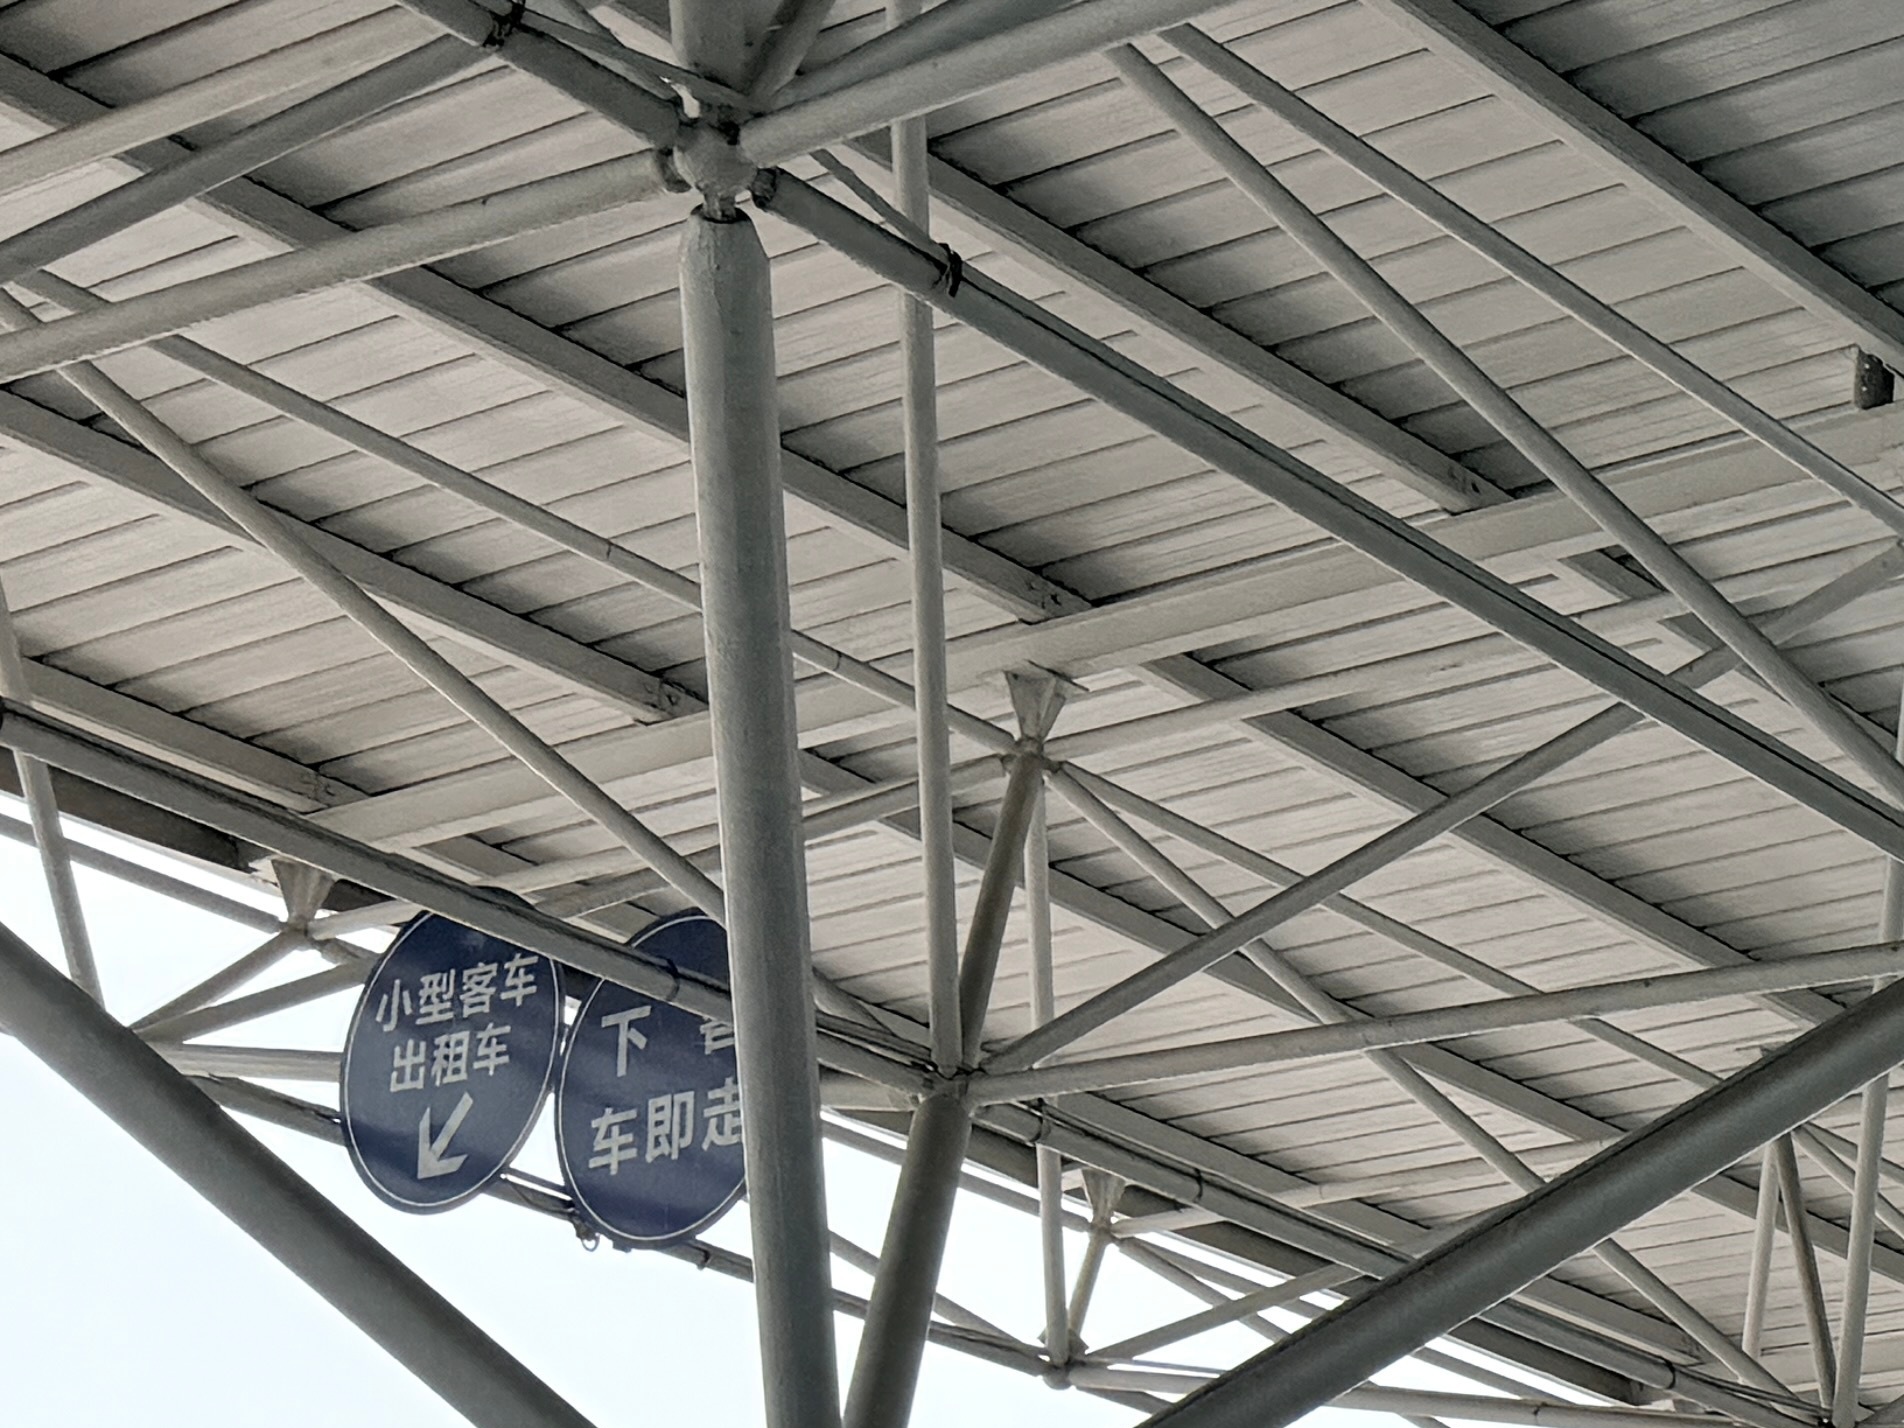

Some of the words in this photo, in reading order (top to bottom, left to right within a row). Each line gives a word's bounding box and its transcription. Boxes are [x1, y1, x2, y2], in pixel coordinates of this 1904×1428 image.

[375, 953, 538, 1032] 小型客车
[390, 1023, 511, 1093] 出租车
